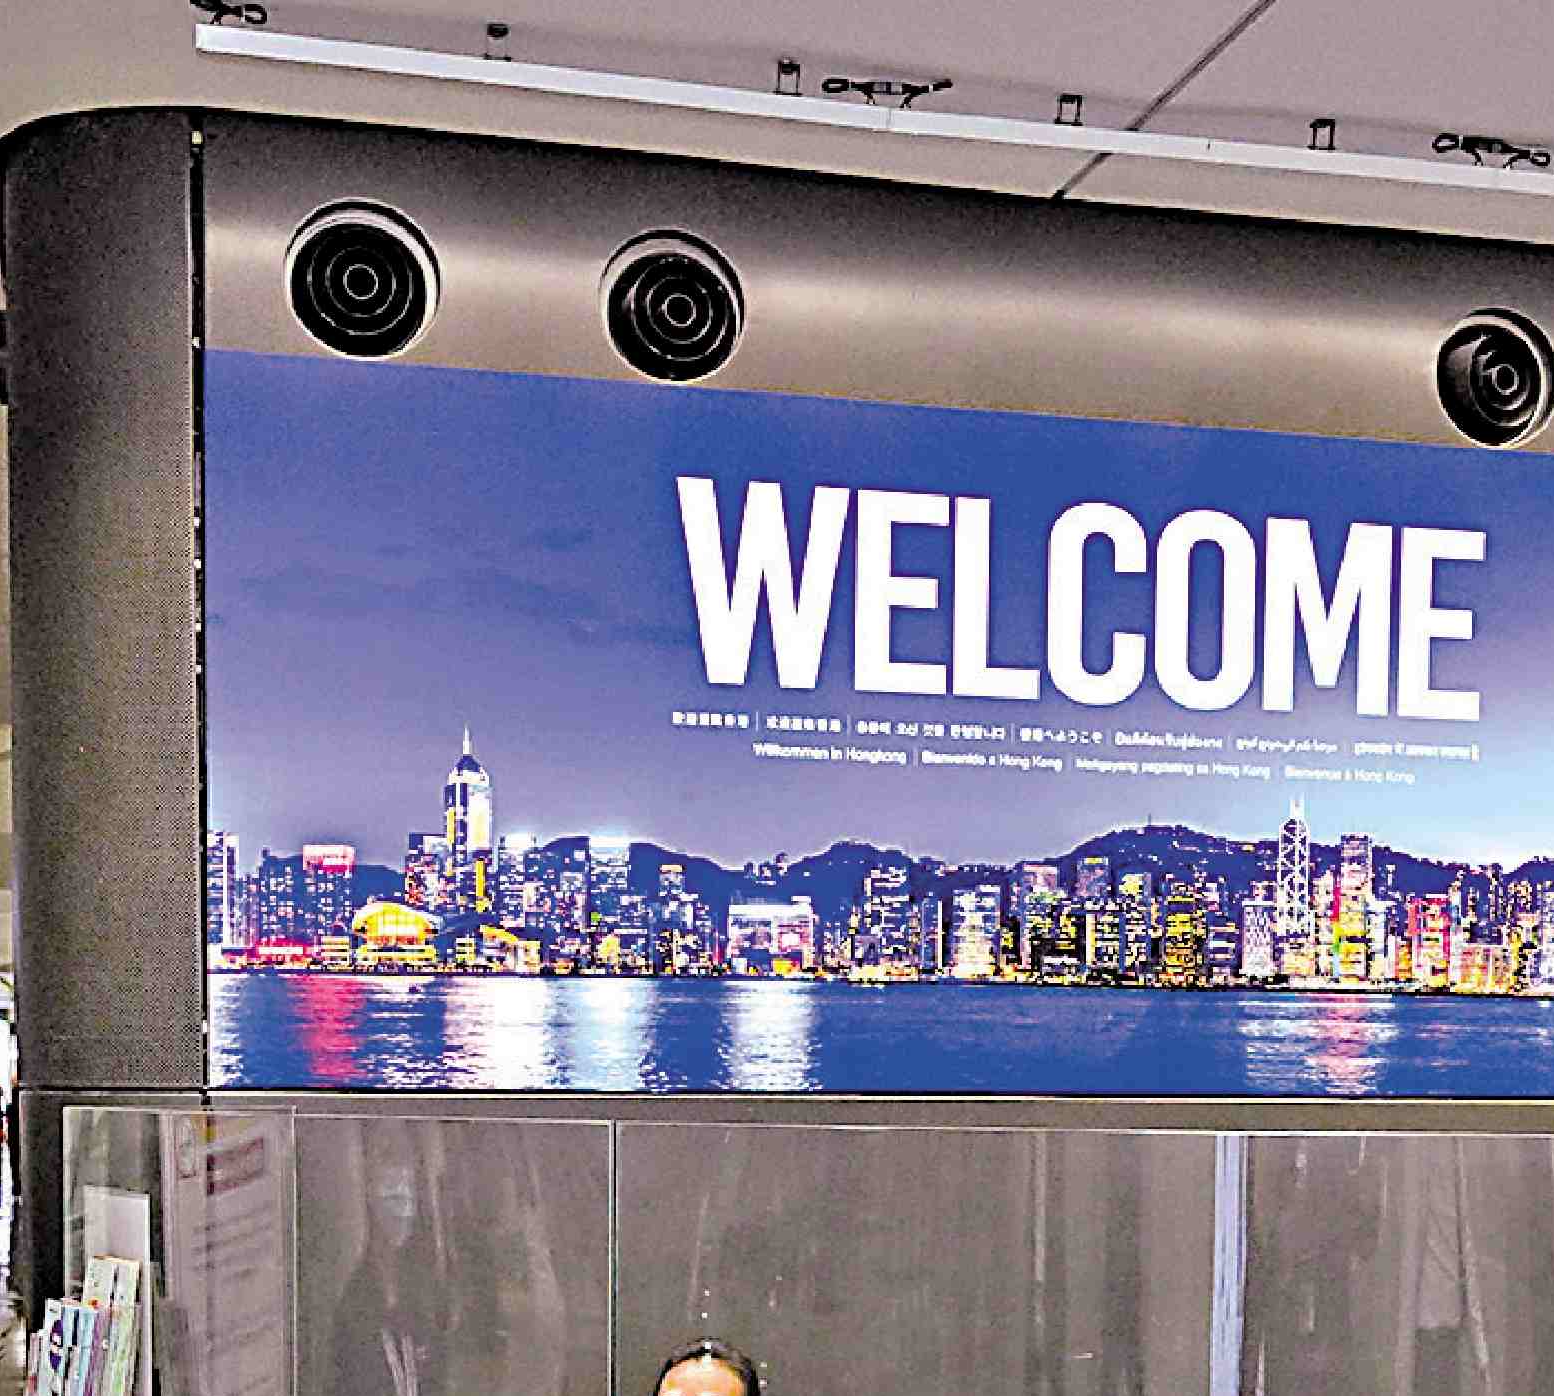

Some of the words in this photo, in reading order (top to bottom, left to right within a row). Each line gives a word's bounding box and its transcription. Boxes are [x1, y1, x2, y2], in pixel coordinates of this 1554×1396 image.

[677, 476, 1486, 722] WELCOME
[999, 753, 1031, 770] Hong
[1033, 755, 1064, 771] Kong
[1355, 768, 1384, 783] Hong
[1387, 769, 1416, 784] Kong
